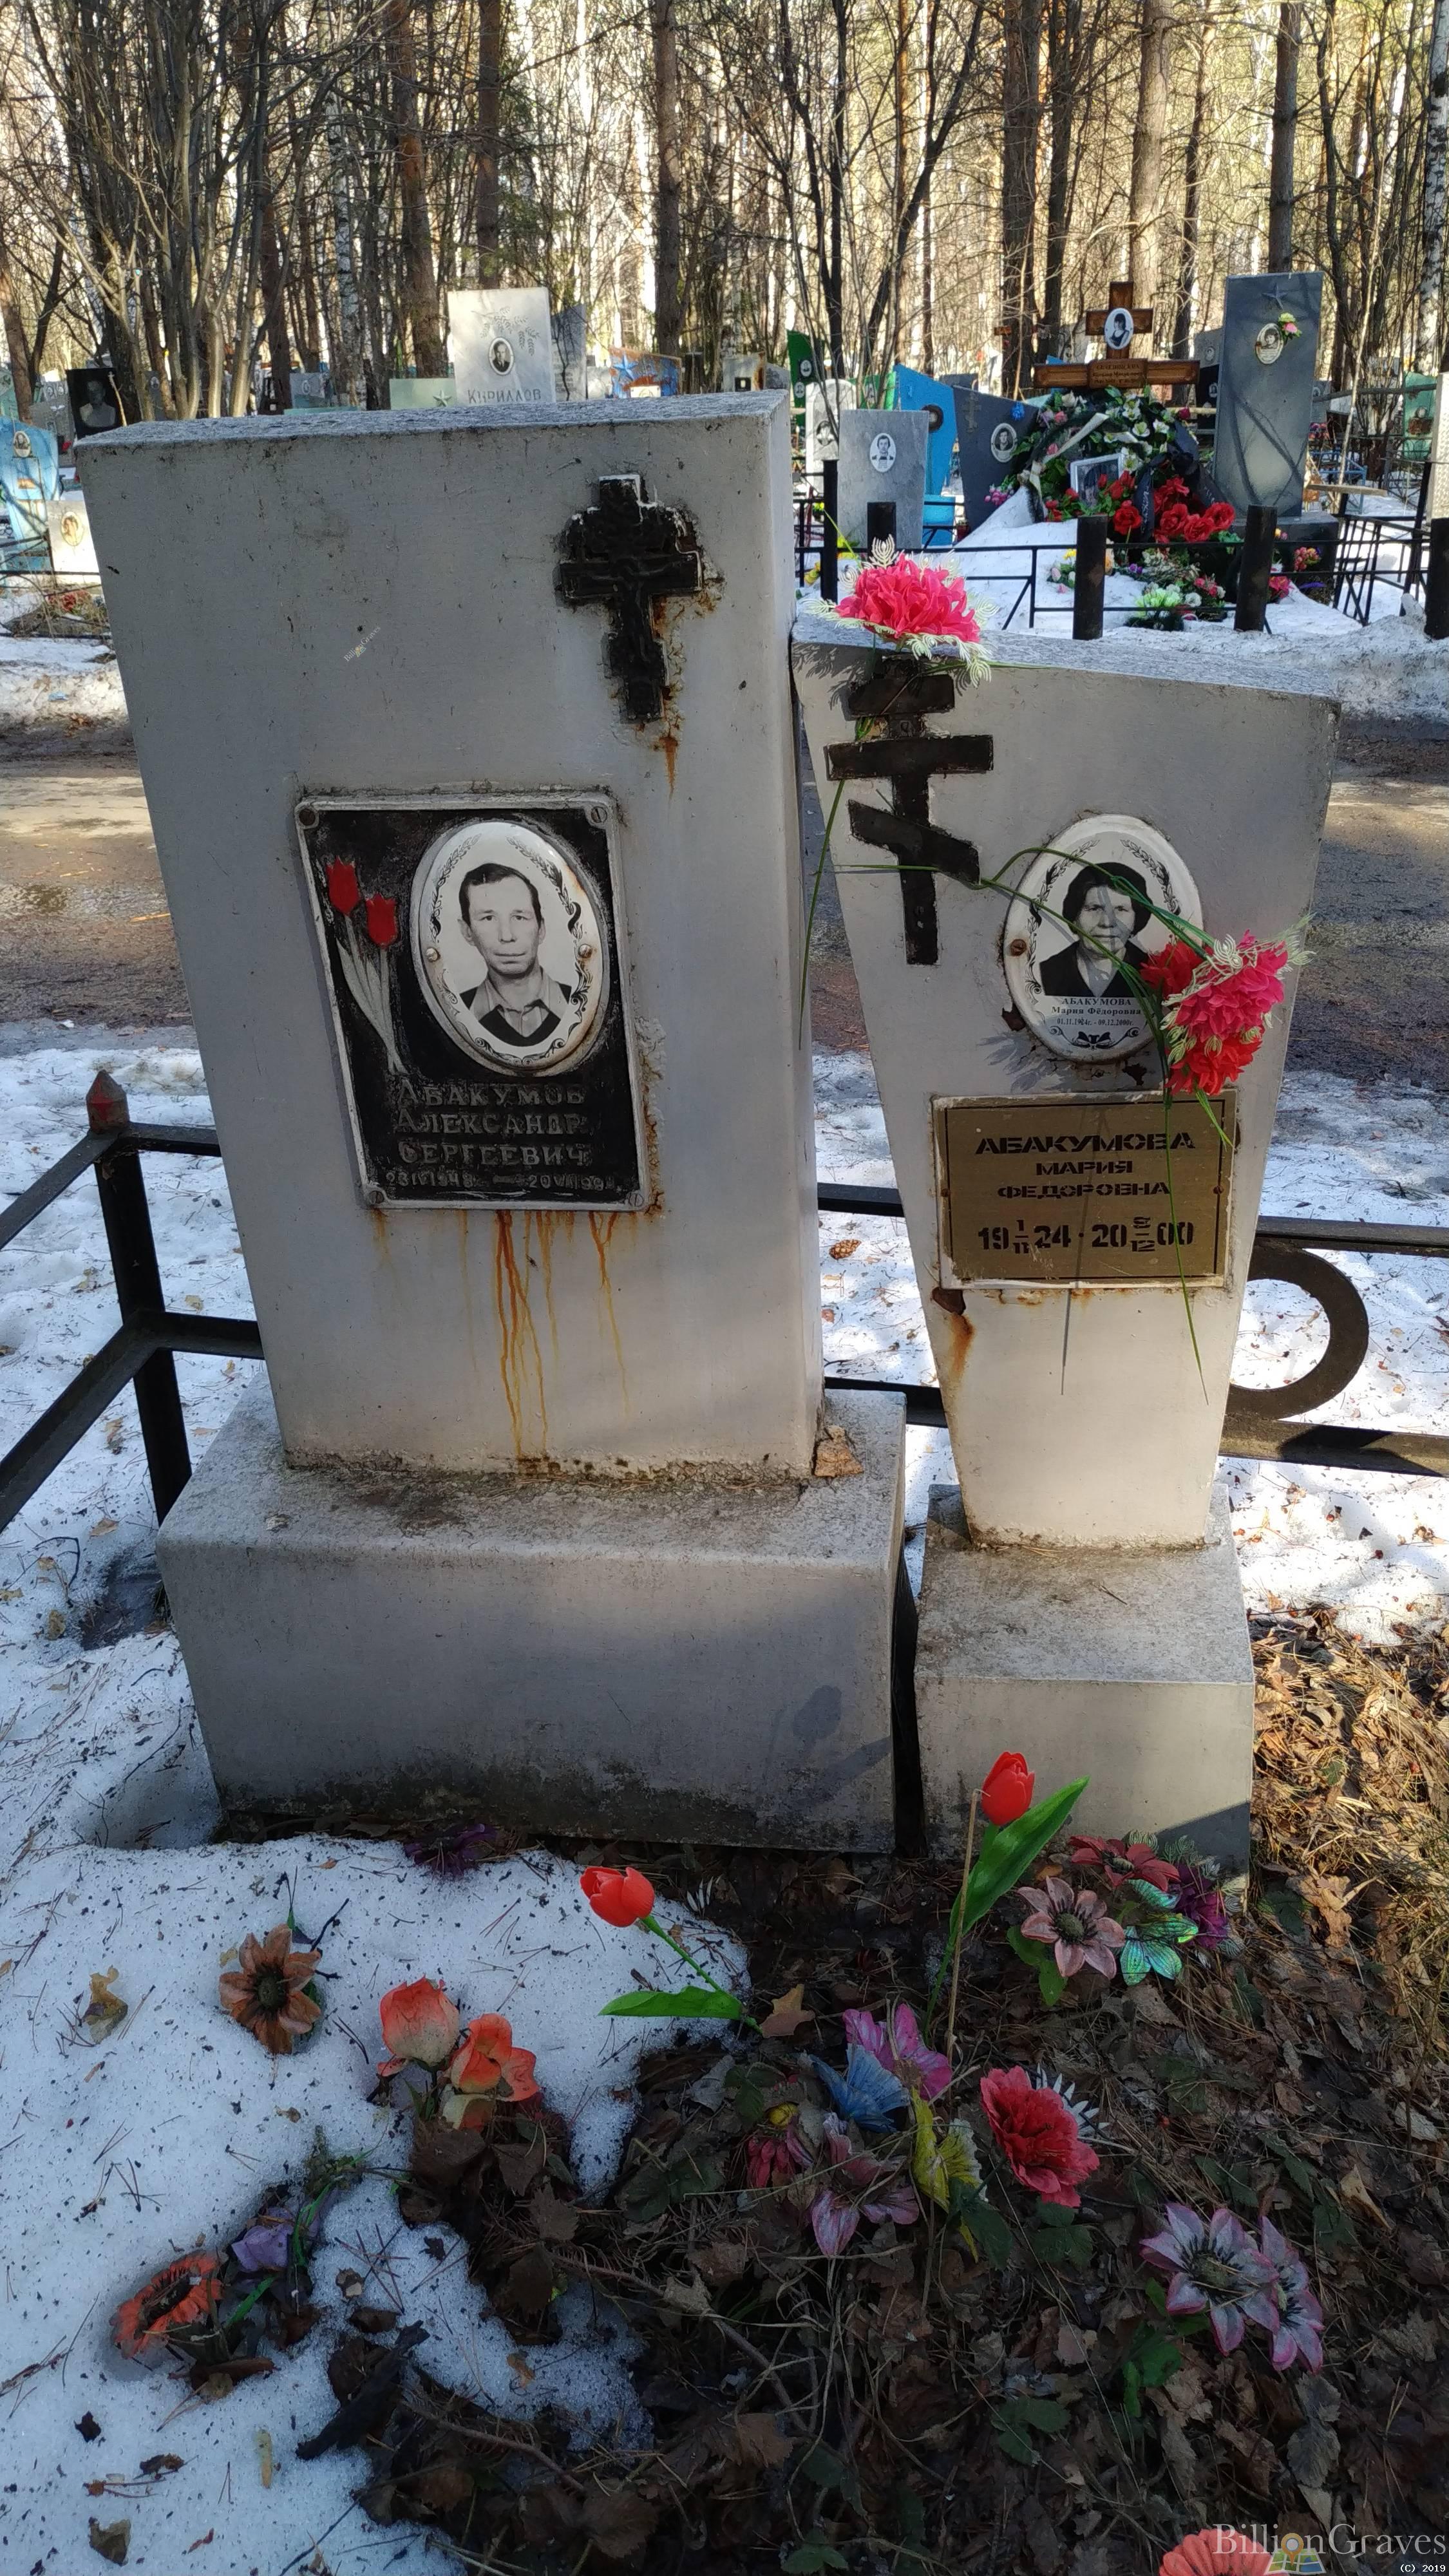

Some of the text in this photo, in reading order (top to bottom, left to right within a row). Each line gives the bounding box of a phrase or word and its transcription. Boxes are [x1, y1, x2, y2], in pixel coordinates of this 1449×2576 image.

[468, 388, 542, 404] КИРИЛЛОВ
[1051, 1006, 1141, 1017] Мария Фёдоровна
[396, 1079, 586, 1106] АБАКУМОВ
[396, 1108, 585, 1135] АЛЕКСАНДР
[398, 1139, 589, 1166] СЕРГЕЕВИЧ
[975, 1132, 1196, 1155] АБАКУМОВА
[1036, 1160, 1133, 1176] МАРИЯ
[998, 1182, 1171, 1199] ФЕДОРОВНА
